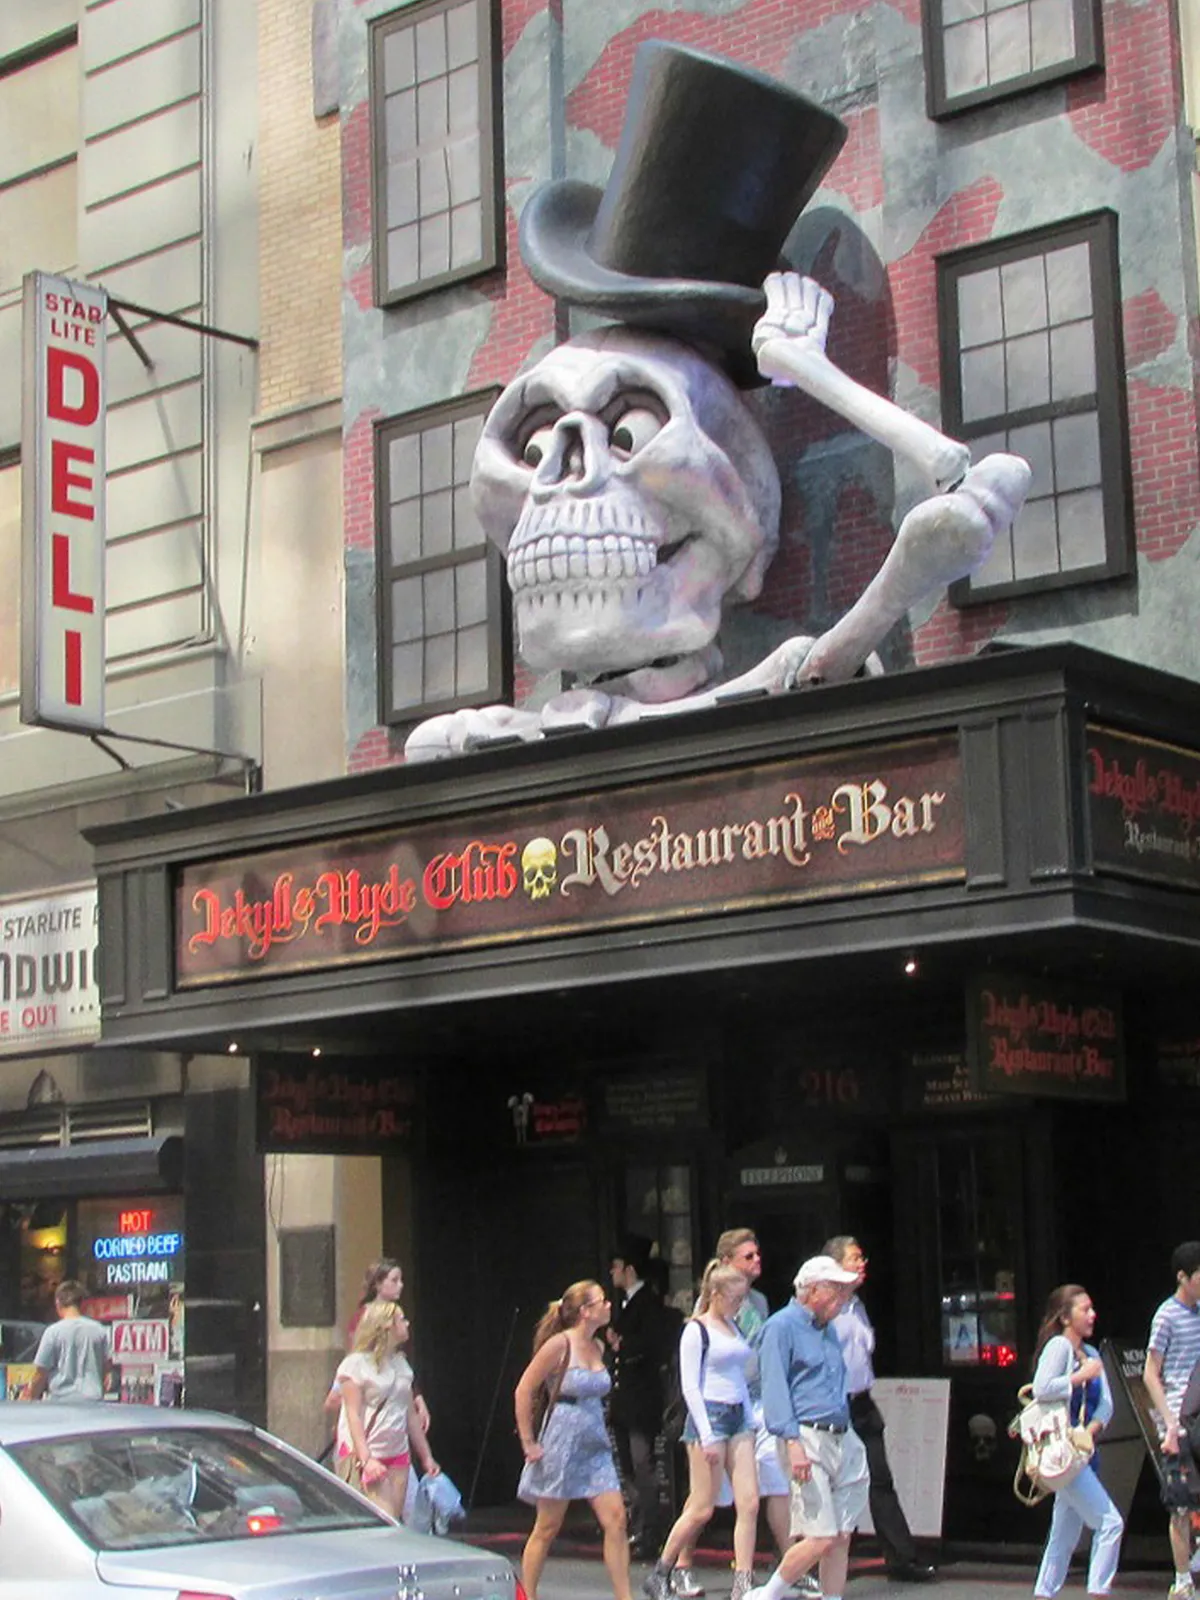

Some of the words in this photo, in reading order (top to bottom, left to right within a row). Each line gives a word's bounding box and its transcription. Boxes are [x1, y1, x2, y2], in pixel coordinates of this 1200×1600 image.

[45, 292, 101, 324] STAR
[51, 317, 95, 347] LITE
[46, 345, 100, 706] DELI
[188, 871, 294, 959] Jekyll
[314, 863, 417, 945] Hyde
[422, 840, 518, 911] Club
[560, 792, 811, 897] Restaurant
[831, 779, 946, 855] Bar
[4, 906, 82, 939] STARLITE
[0, 946, 99, 1001] DWI
[22, 1003, 57, 1030] OUT
[120, 1210, 152, 1233] HOT
[94, 1236, 146, 1259] CORNED
[147, 1233, 179, 1256] BEEF
[120, 1324, 163, 1351] ATM
